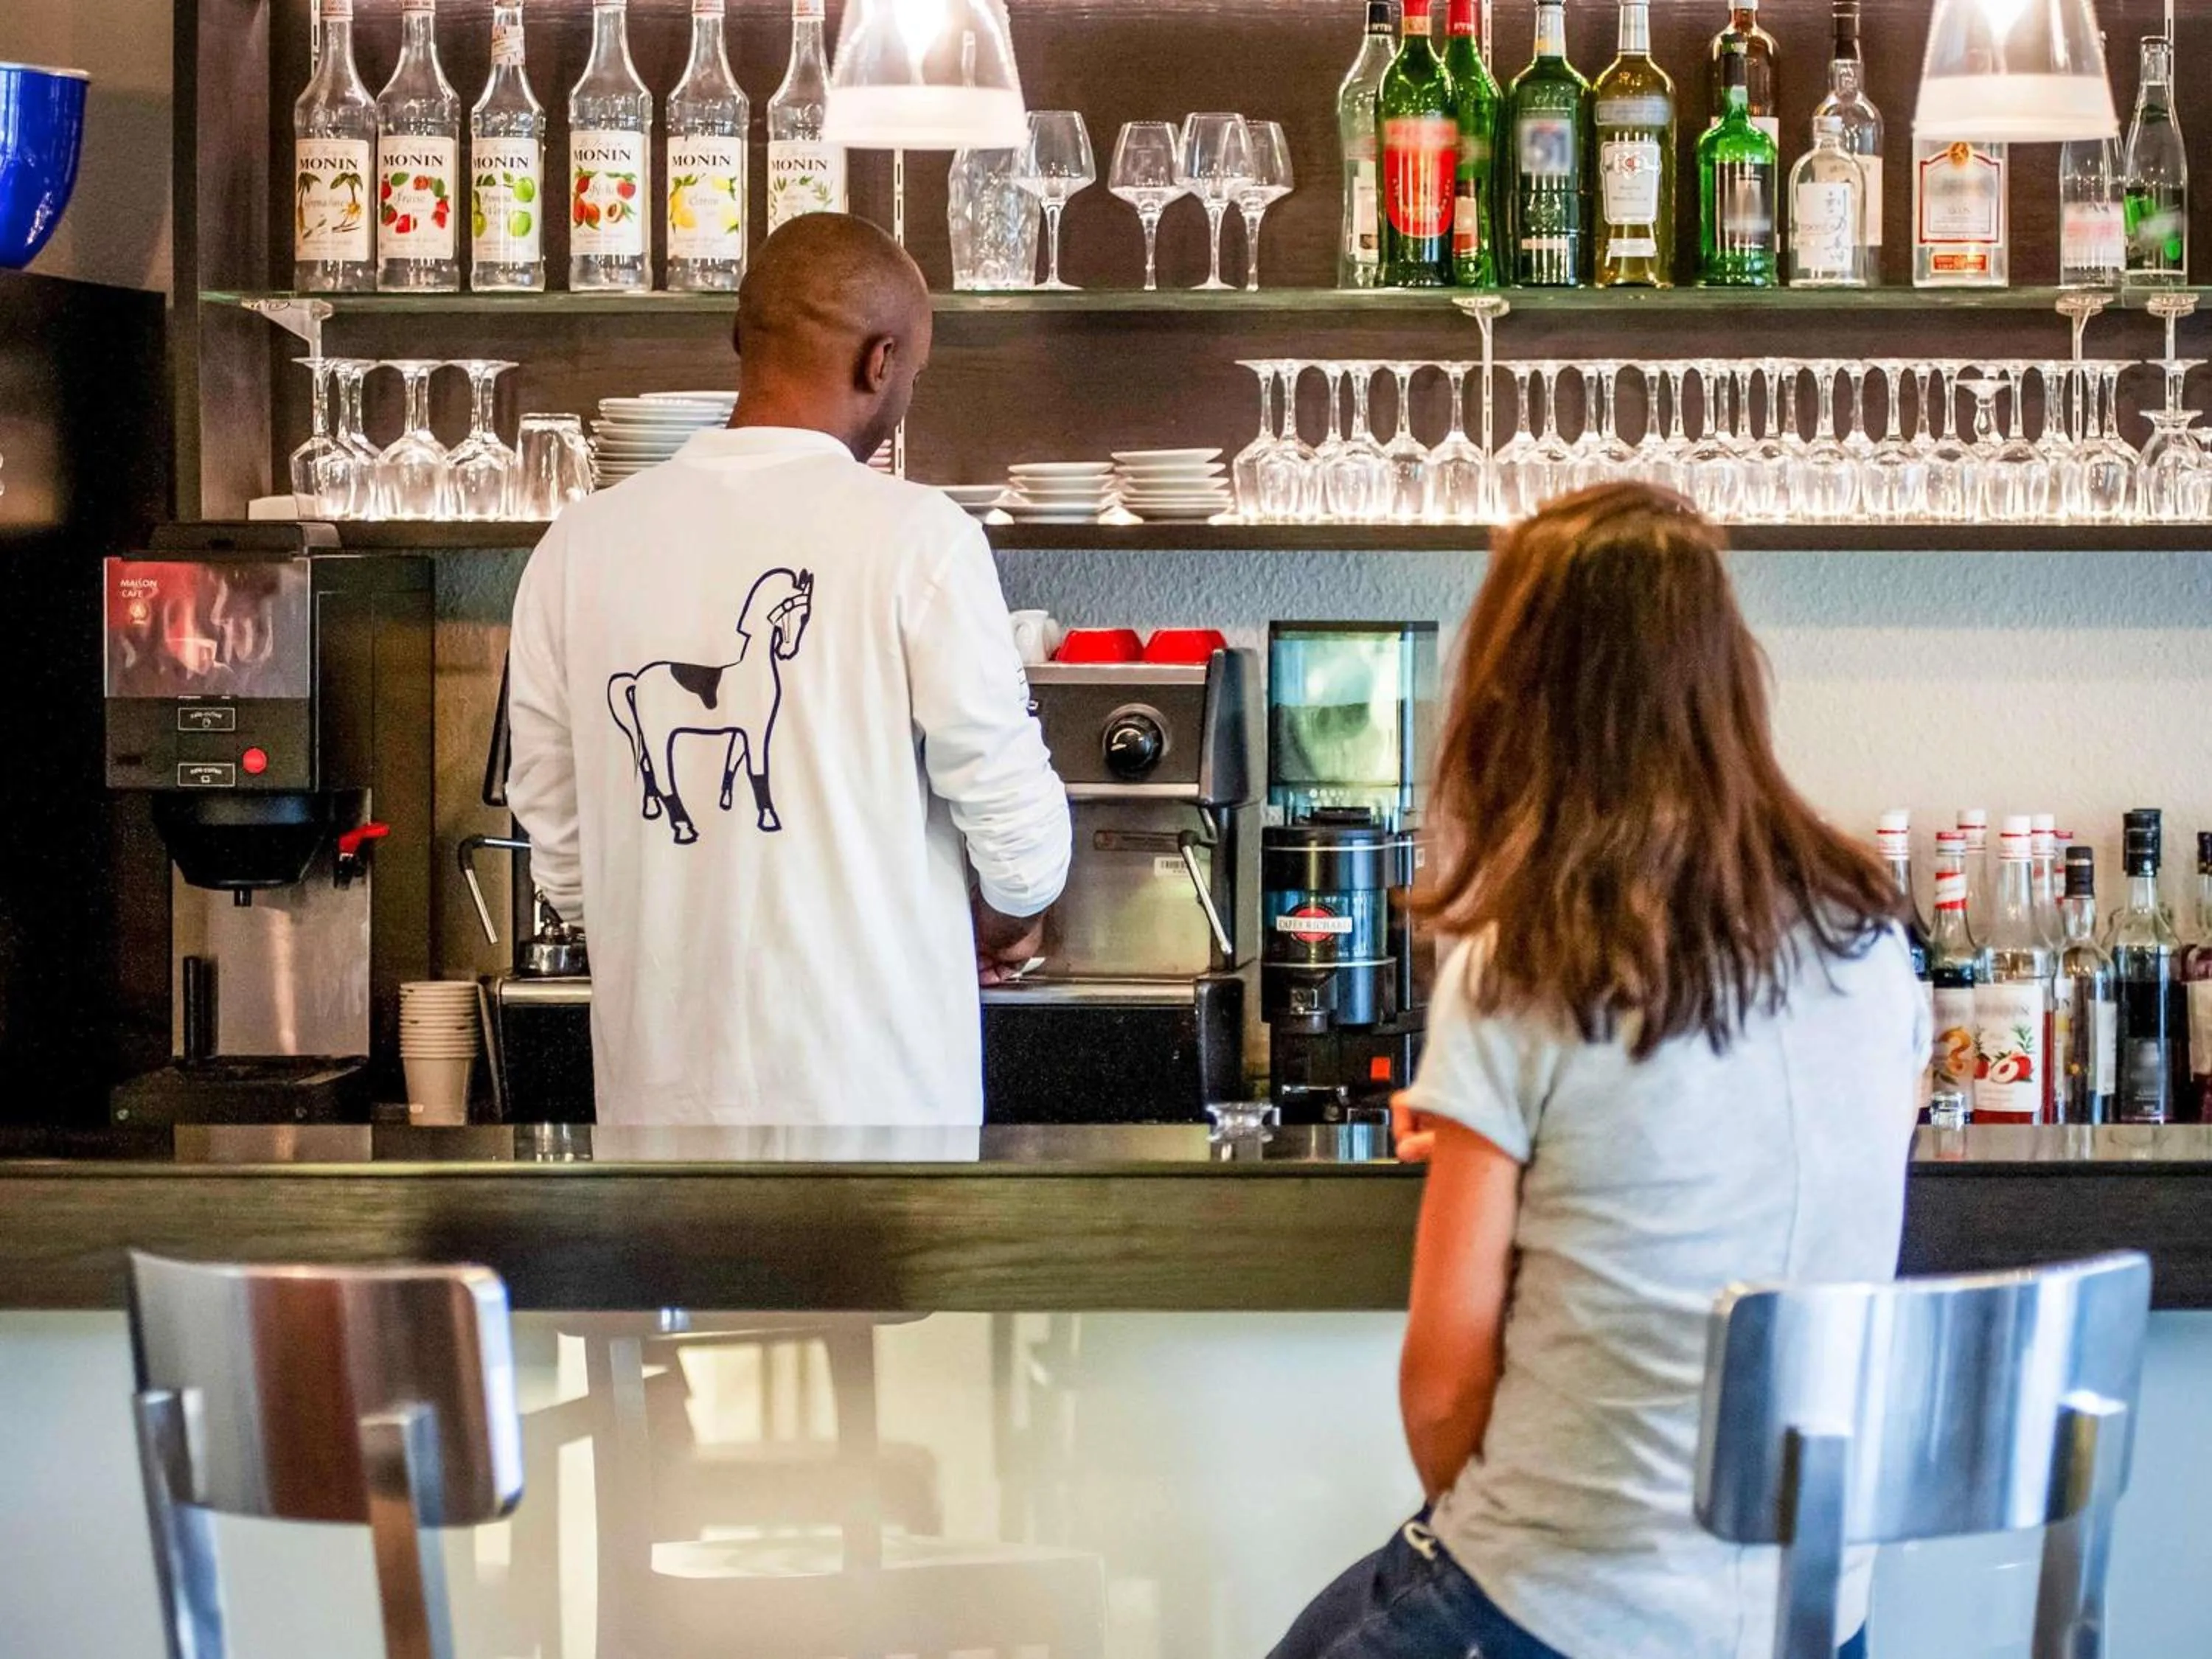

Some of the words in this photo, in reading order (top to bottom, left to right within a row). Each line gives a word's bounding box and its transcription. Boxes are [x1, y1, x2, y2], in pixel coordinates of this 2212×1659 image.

[573, 149, 631, 160] MONIN
[299, 157, 358, 170] MONIN
[383, 155, 443, 166] MONIN
[473, 155, 529, 168] MONIN
[672, 155, 731, 166] MONIN
[771, 159, 827, 170] MONIN
